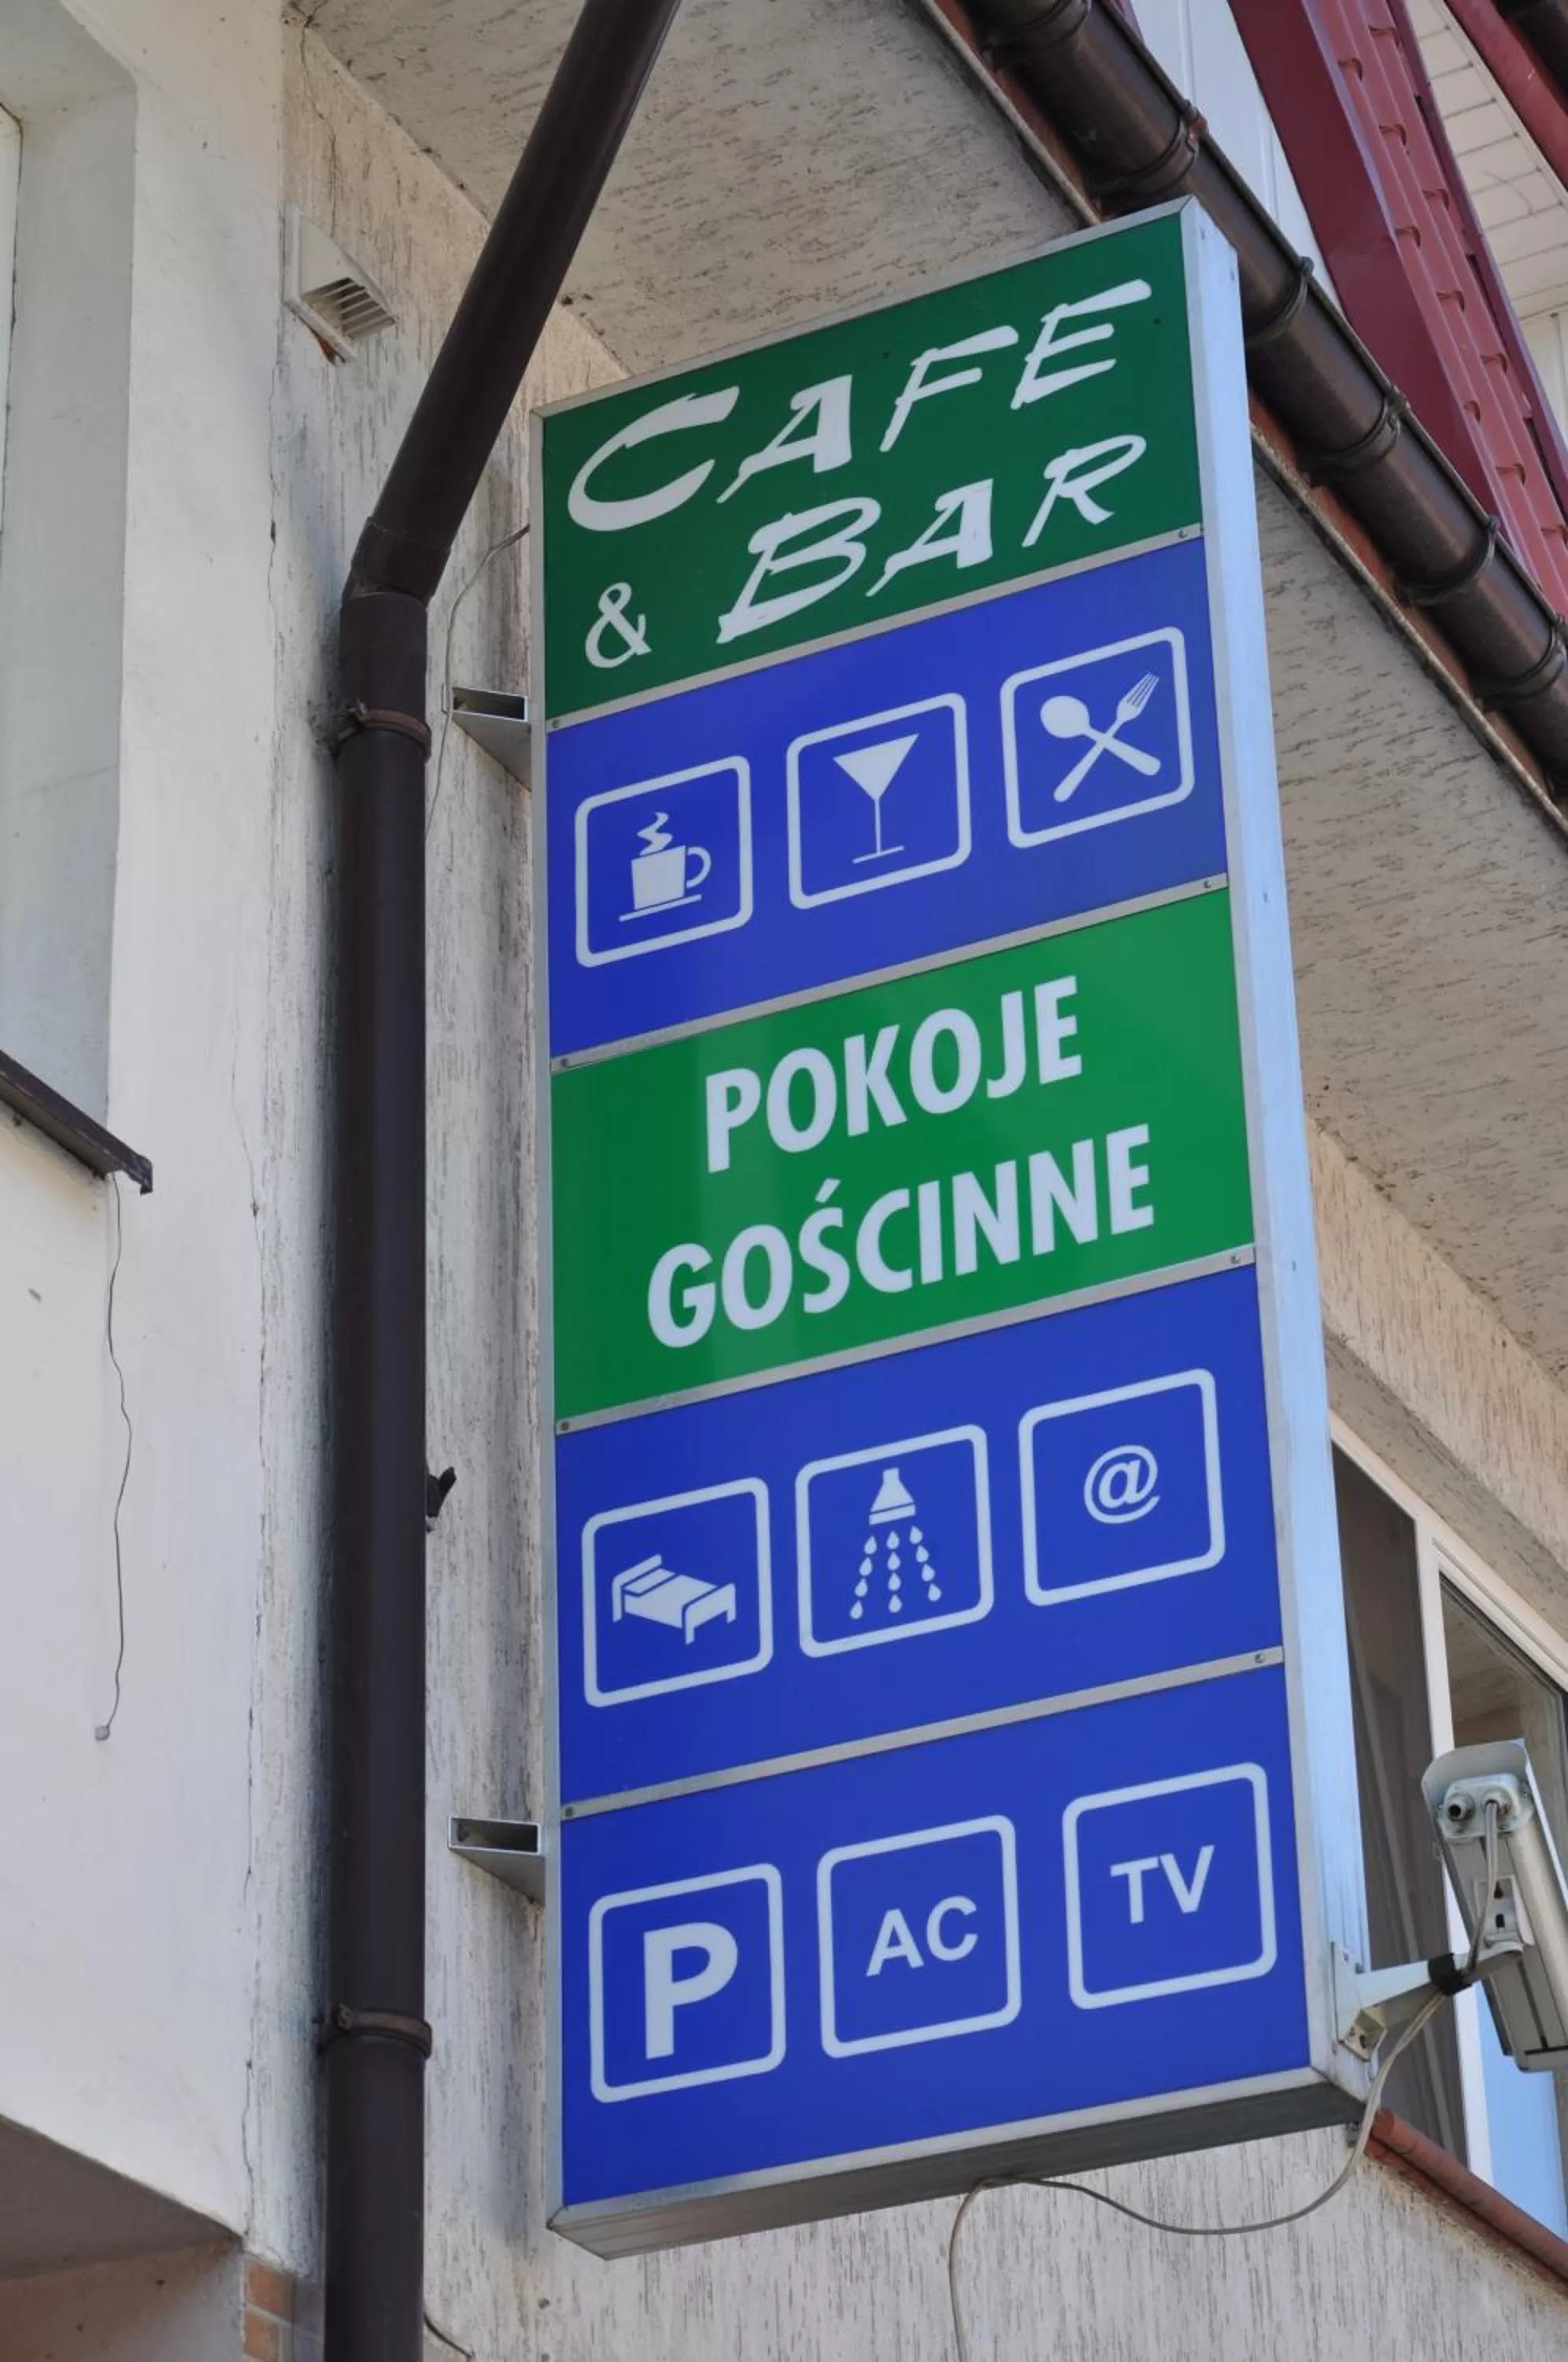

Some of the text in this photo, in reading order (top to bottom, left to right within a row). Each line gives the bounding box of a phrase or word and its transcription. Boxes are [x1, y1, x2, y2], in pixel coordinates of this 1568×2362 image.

[568, 278, 1152, 531] CAFE
[585, 434, 1147, 668] & BAR
[705, 976, 1082, 1173] POKOJE
[648, 1124, 1154, 1348] GOŚCINNE
[1084, 1445, 1159, 1523] @
[867, 1896, 977, 1975] AC
[1111, 1846, 1213, 1923] TV
[644, 1923, 738, 2058] P
